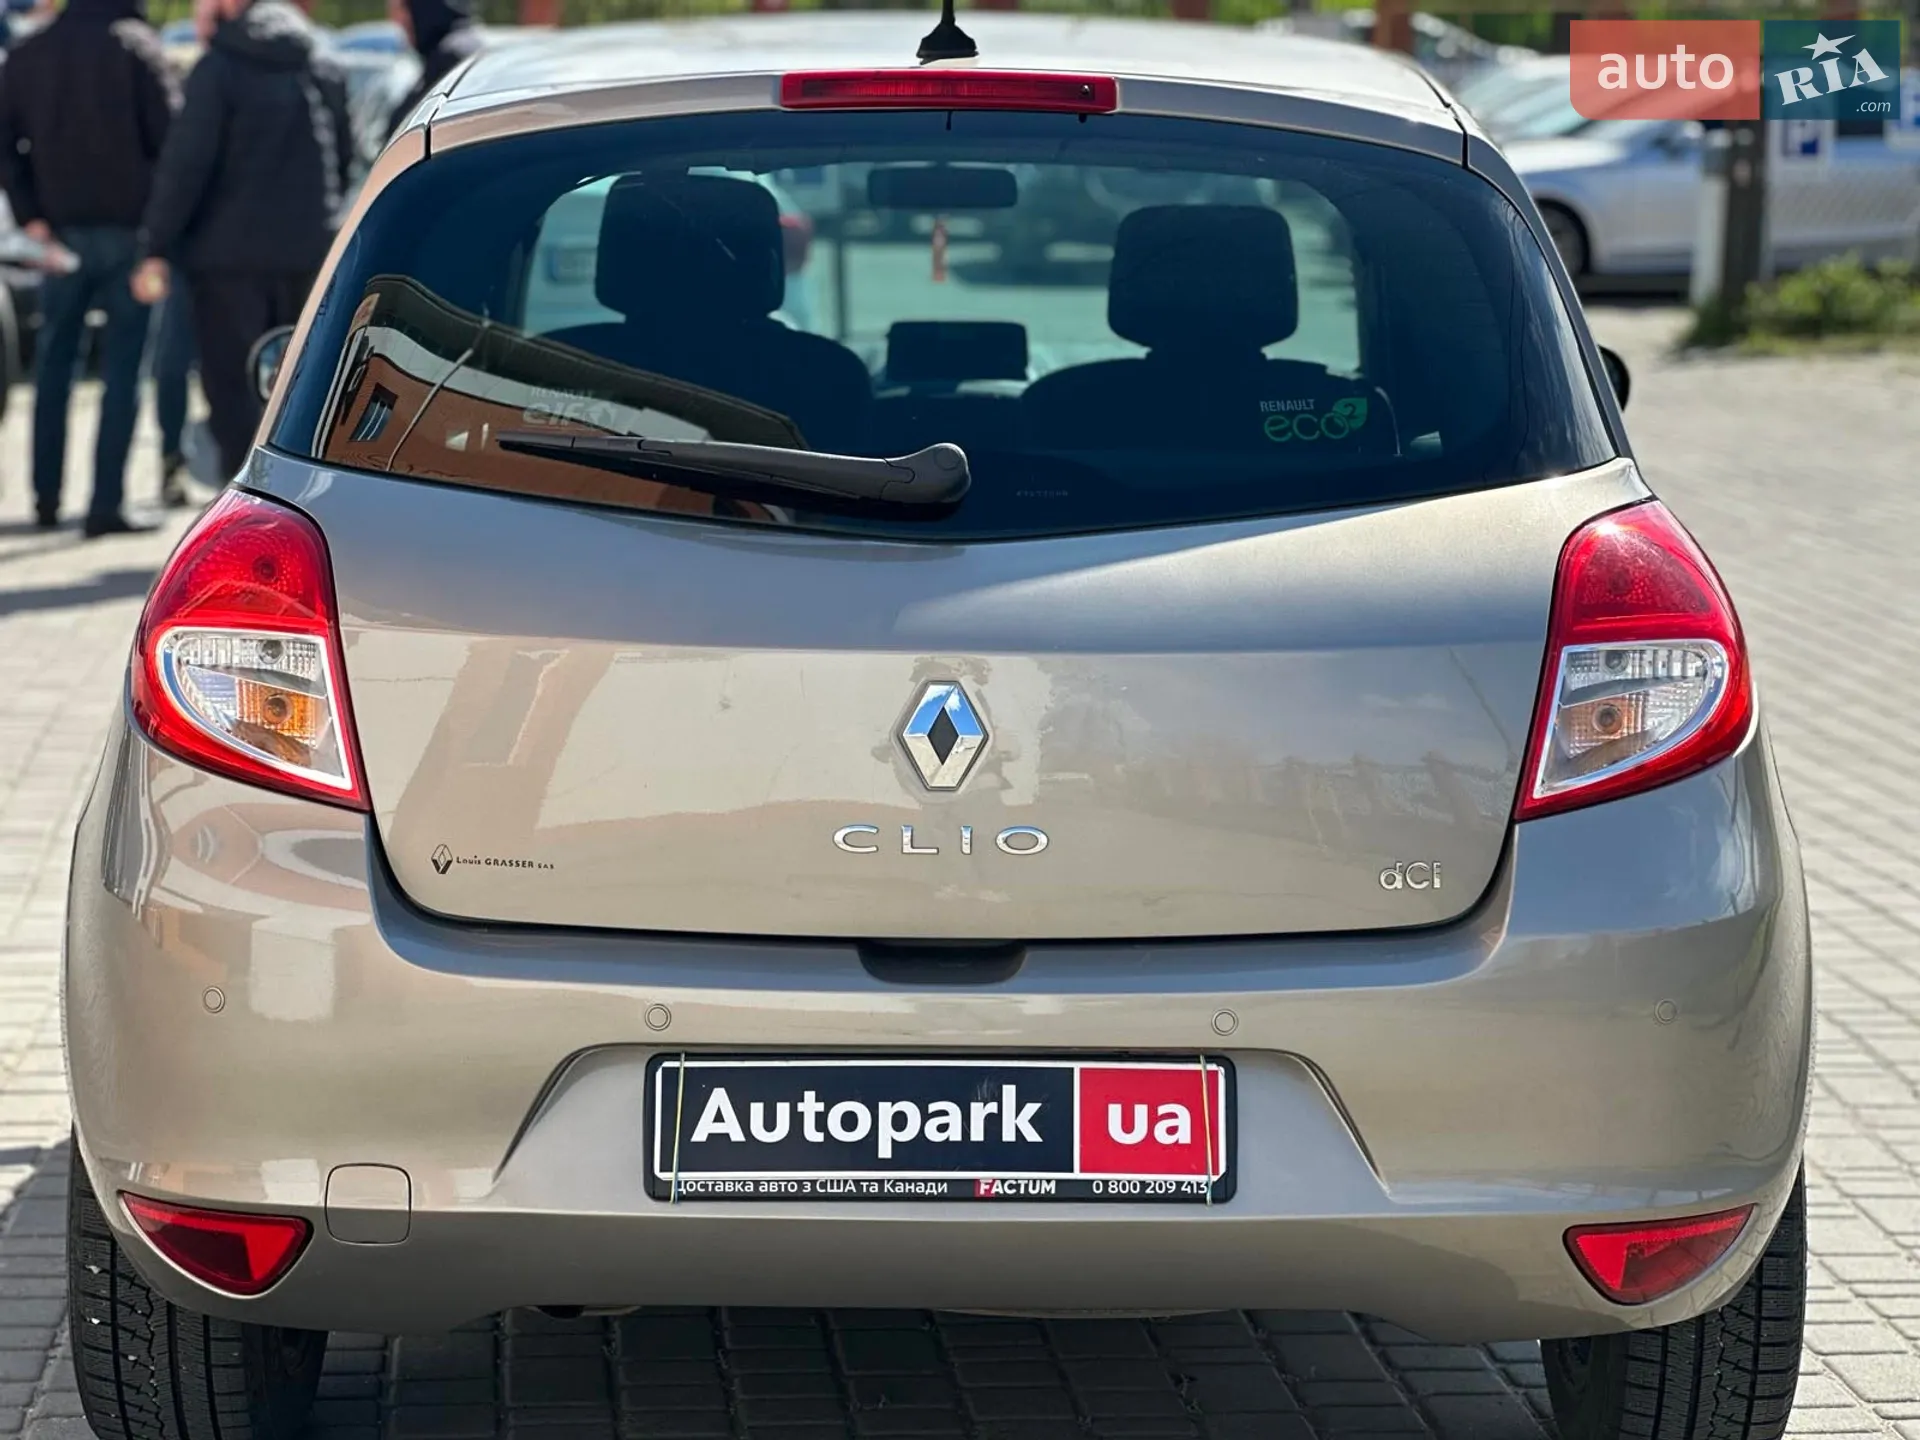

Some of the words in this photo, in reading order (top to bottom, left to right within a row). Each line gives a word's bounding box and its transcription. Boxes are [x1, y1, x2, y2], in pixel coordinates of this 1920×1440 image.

[1260, 399, 1315, 412] RENAULT
[833, 824, 1050, 855] CLIO
[484, 858, 534, 868] GRASSER
[691, 1085, 1043, 1158] Autopark
[1107, 1103, 1192, 1145] ua
[759, 1181, 798, 1192] авто
[816, 1179, 856, 1192] США
[860, 1181, 879, 1192] та
[884, 1180, 948, 1195] Канади
[980, 1179, 1056, 1195] FACTUM
[1092, 1180, 1103, 1194] 0
[1108, 1180, 1140, 1194] 800
[1145, 1180, 1176, 1194] 209
[1181, 1180, 1207, 1194] 413
